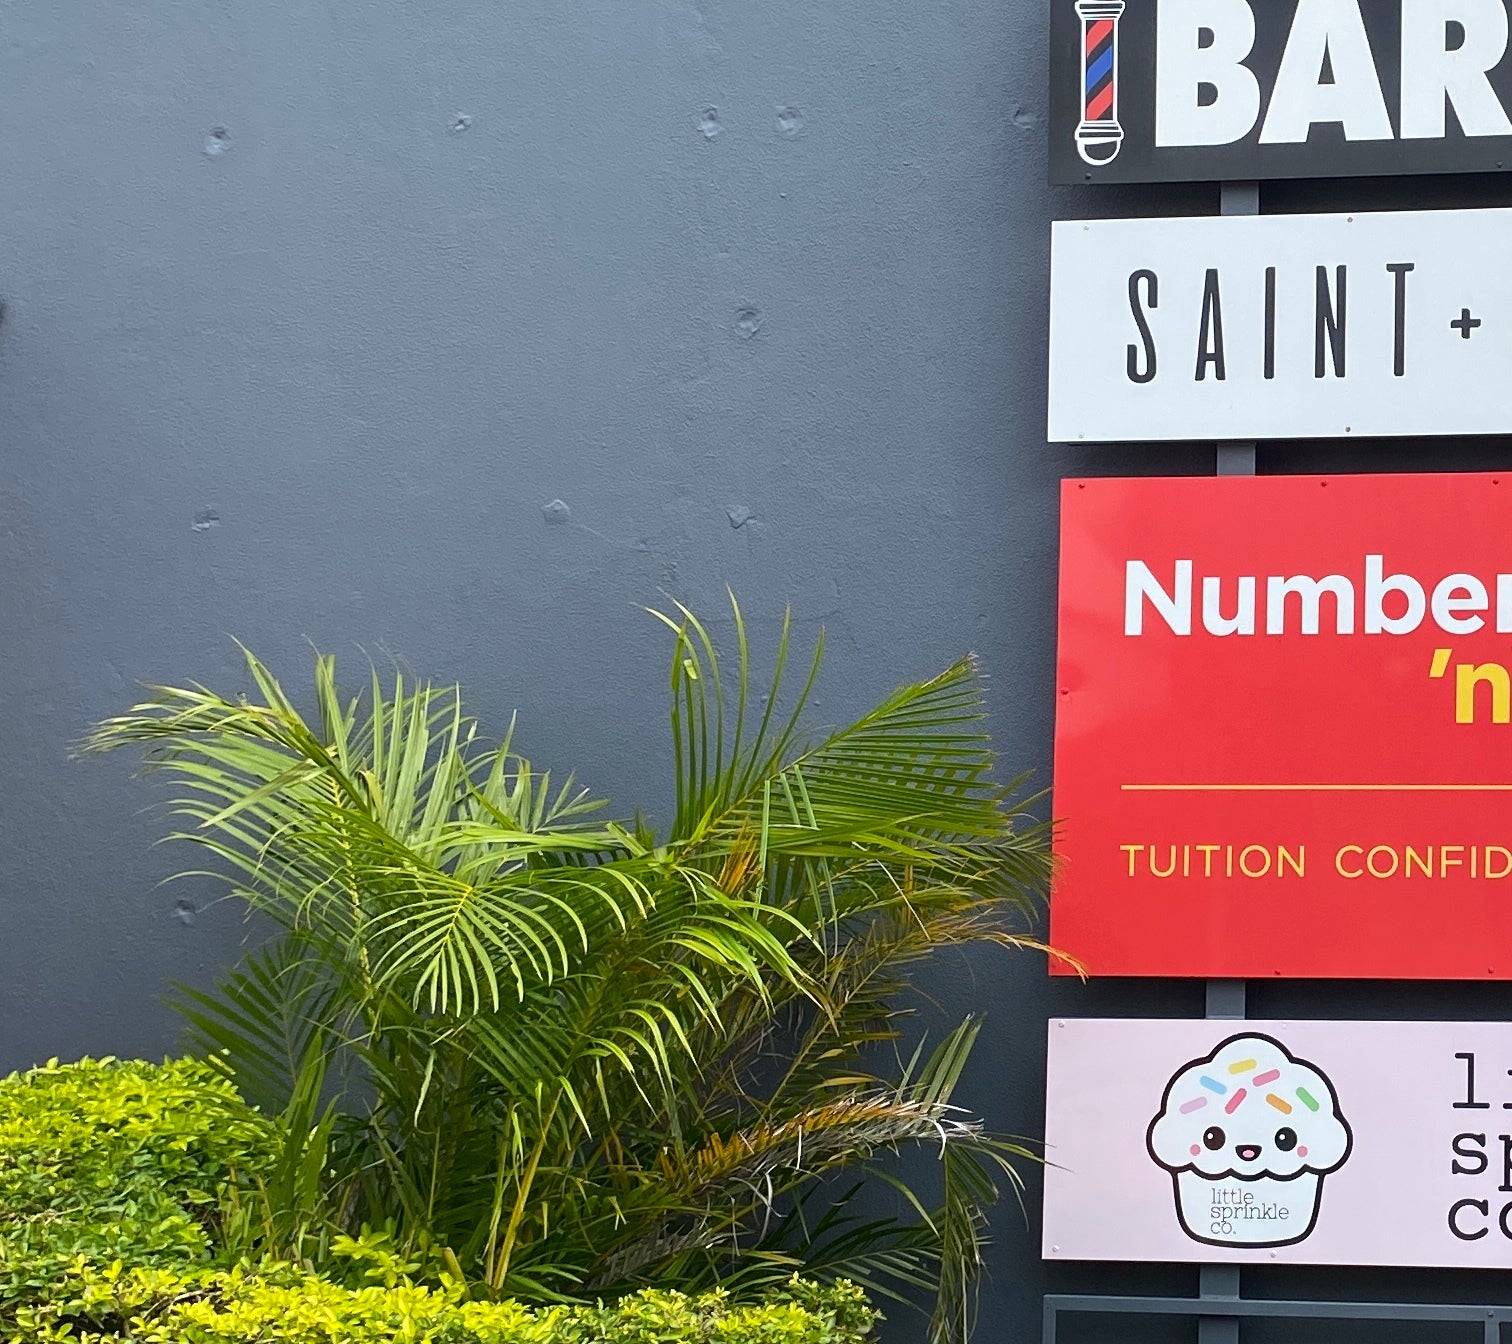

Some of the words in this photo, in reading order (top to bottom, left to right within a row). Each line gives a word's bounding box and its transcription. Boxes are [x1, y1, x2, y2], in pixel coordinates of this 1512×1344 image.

[1126, 262, 1415, 384] SAINT
[1450, 308, 1482, 340] +
[1119, 844, 1306, 878] TUITION
[1211, 1188, 1254, 1205] little
[1210, 1202, 1290, 1223] sprinkle
[1210, 1222, 1237, 1235] co.
